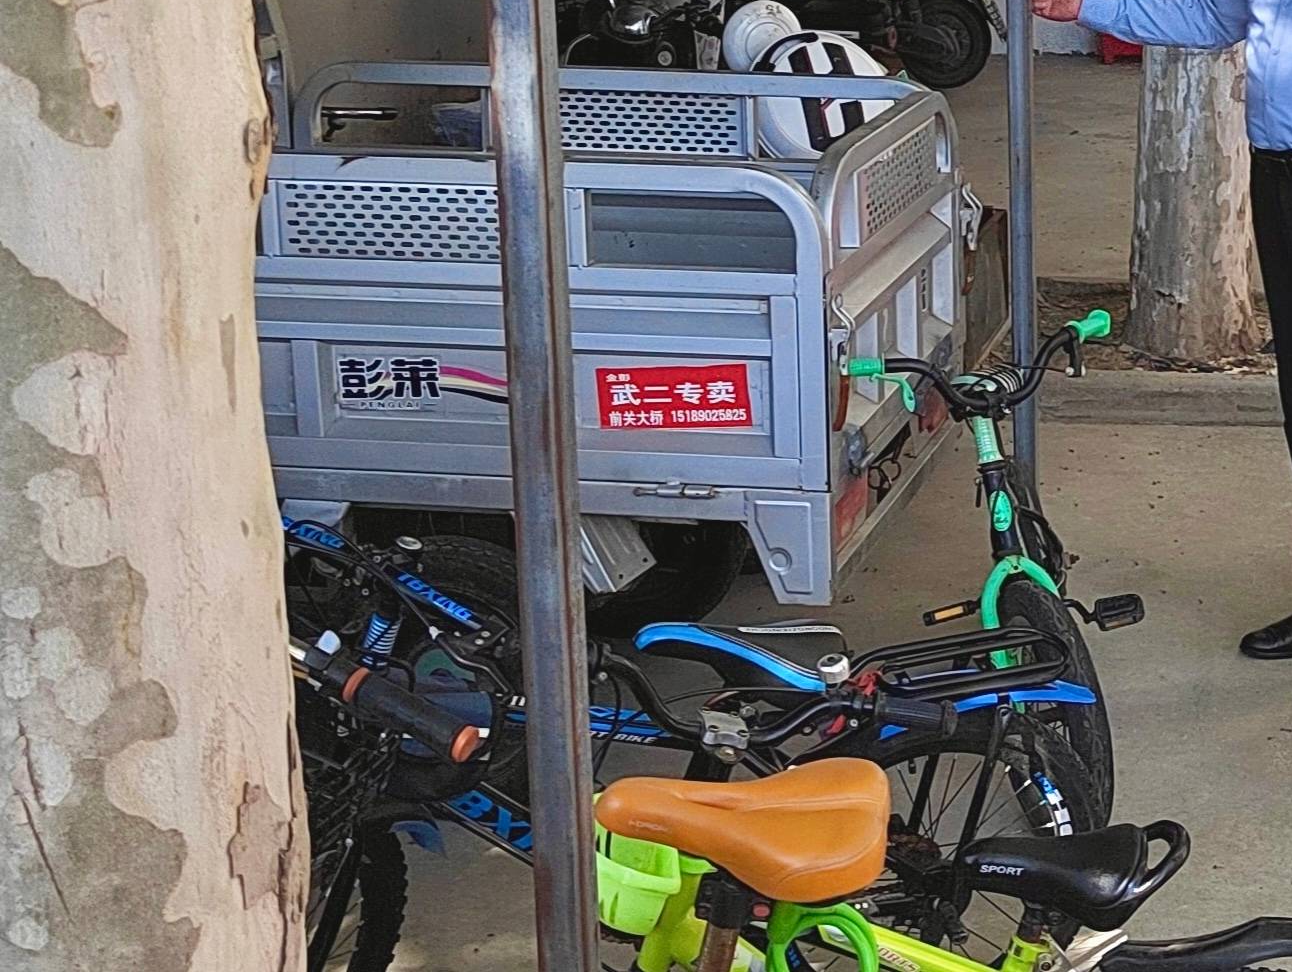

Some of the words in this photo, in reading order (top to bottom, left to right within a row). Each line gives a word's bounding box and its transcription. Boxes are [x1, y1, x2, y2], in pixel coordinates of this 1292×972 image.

[338, 357, 441, 401] 彭莱
[610, 381, 737, 406] 武二专卖
[979, 864, 1025, 876] SPORT
